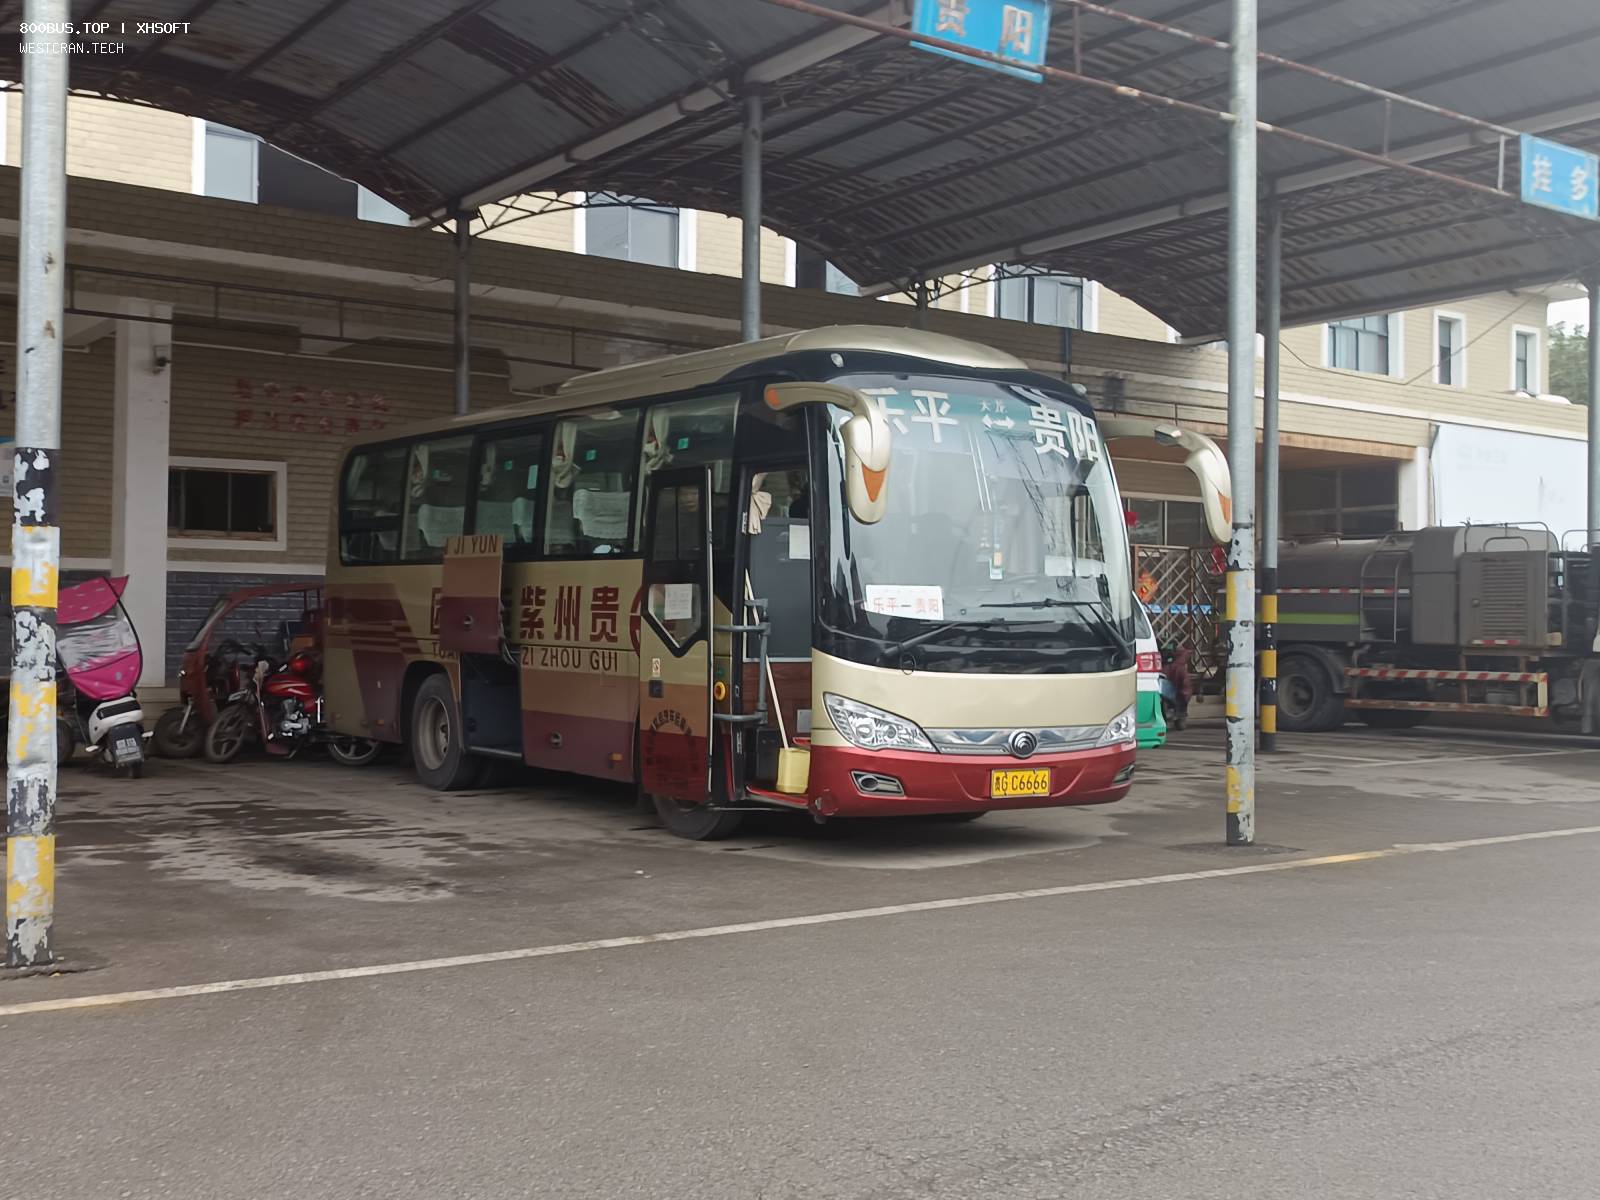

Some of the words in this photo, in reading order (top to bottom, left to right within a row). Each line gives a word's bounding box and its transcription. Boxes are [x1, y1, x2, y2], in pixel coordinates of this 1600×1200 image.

[1028, 404, 1100, 462] 贵阳
[471, 534, 497, 554] YUN
[521, 647, 534, 666] ZI
[541, 647, 581, 669] ZHOU
[590, 650, 617, 672] GUI
